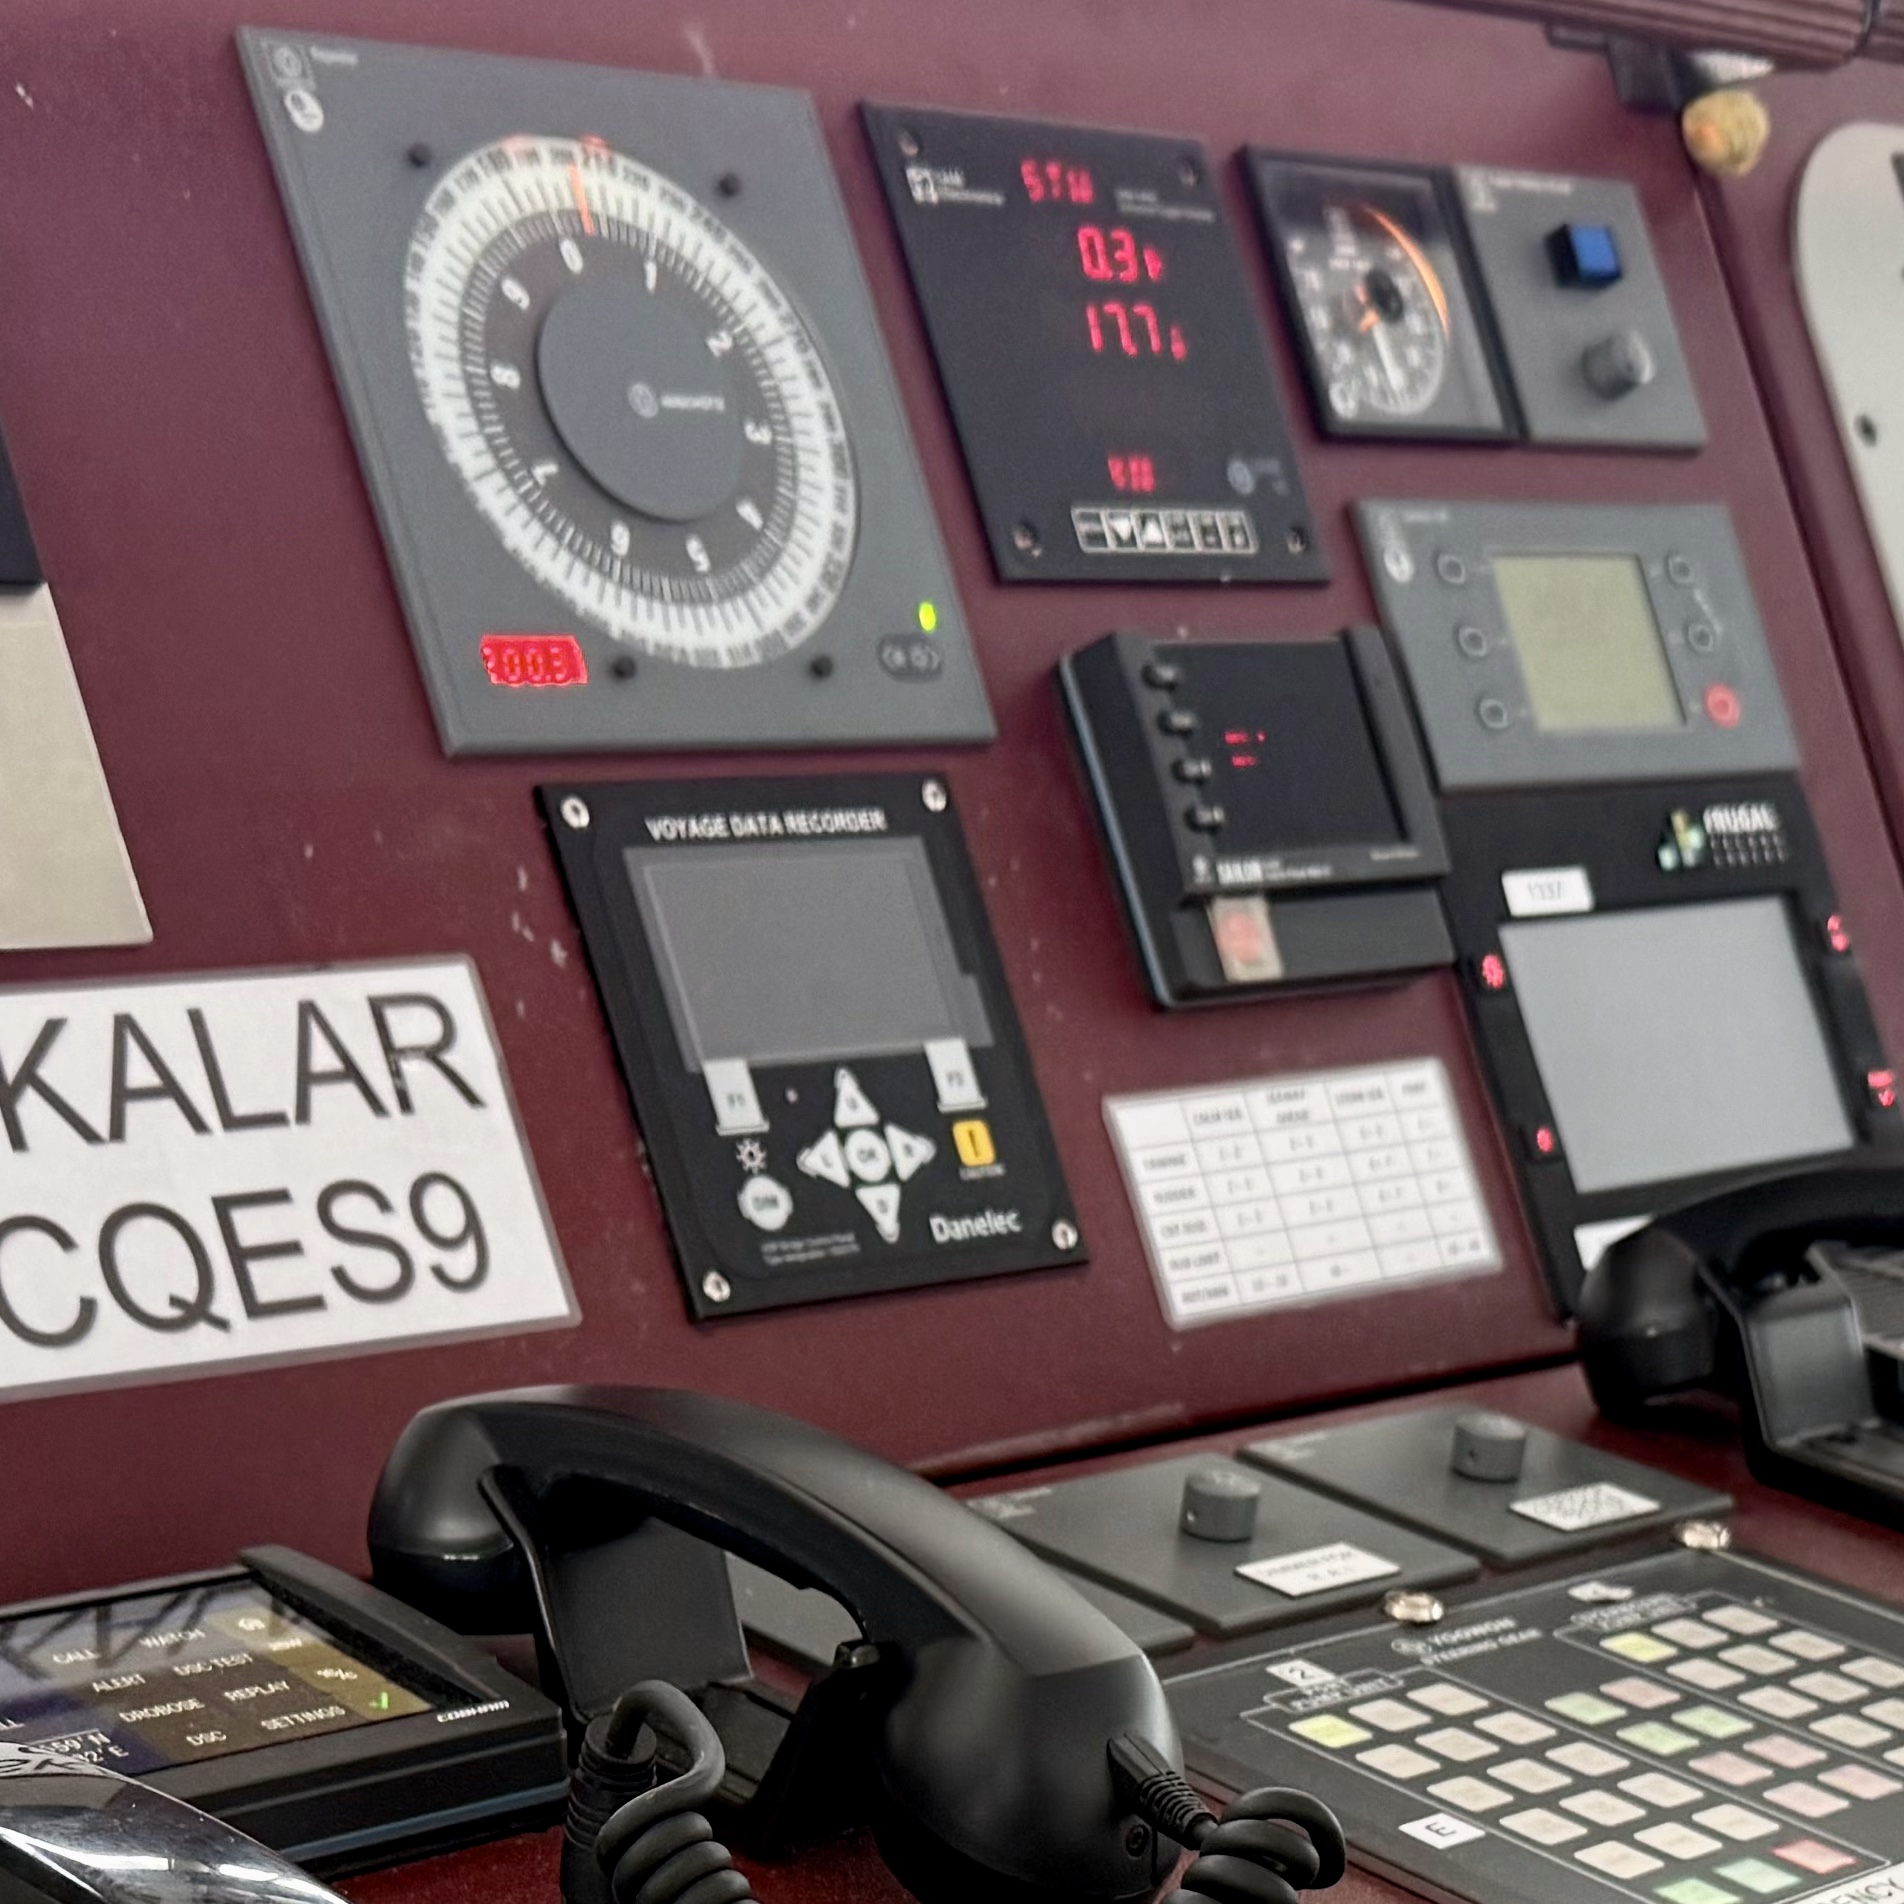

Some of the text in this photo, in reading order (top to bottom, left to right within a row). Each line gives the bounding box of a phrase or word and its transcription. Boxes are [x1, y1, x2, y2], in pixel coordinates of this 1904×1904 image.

[559, 238, 583, 273] 0
[645, 260, 658, 291] 1
[500, 277, 530, 310] 9
[706, 329, 733, 357] 2
[490, 363, 520, 388] 8
[744, 418, 773, 445] 3
[531, 460, 559, 485] 7
[736, 500, 764, 530] 4
[610, 524, 630, 556] 6
[685, 535, 711, 572] 5
[645, 808, 887, 841] VOYAGE DATA RECORDER
[929, 1208, 1022, 1245] Danelec
